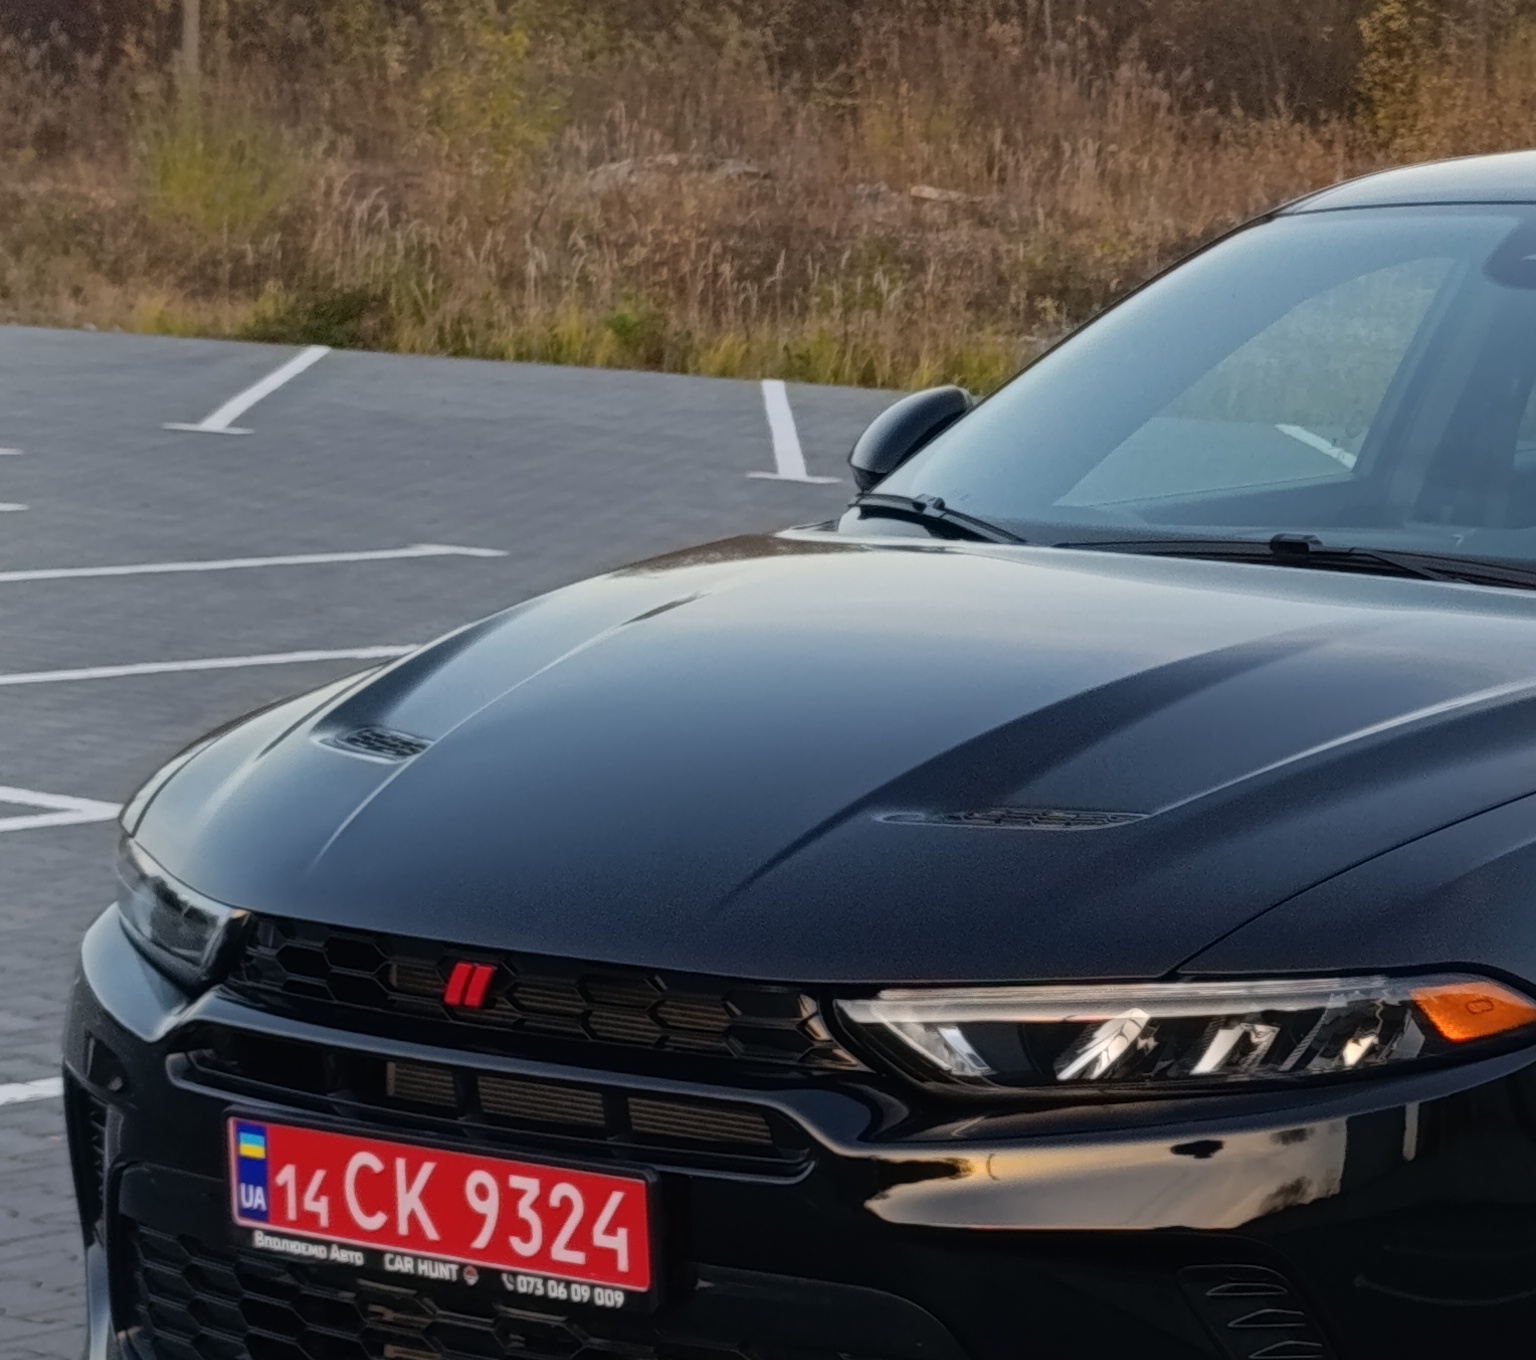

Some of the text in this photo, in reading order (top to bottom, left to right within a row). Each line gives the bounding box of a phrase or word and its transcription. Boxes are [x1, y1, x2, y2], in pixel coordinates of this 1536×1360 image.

[239, 1182, 267, 1212] UA
[275, 1163, 330, 1228] 14
[465, 1169, 629, 1273] 9324
[383, 1252, 460, 1282] CAR HUNT
[516, 1274, 625, 1309] 073 06 09 009
